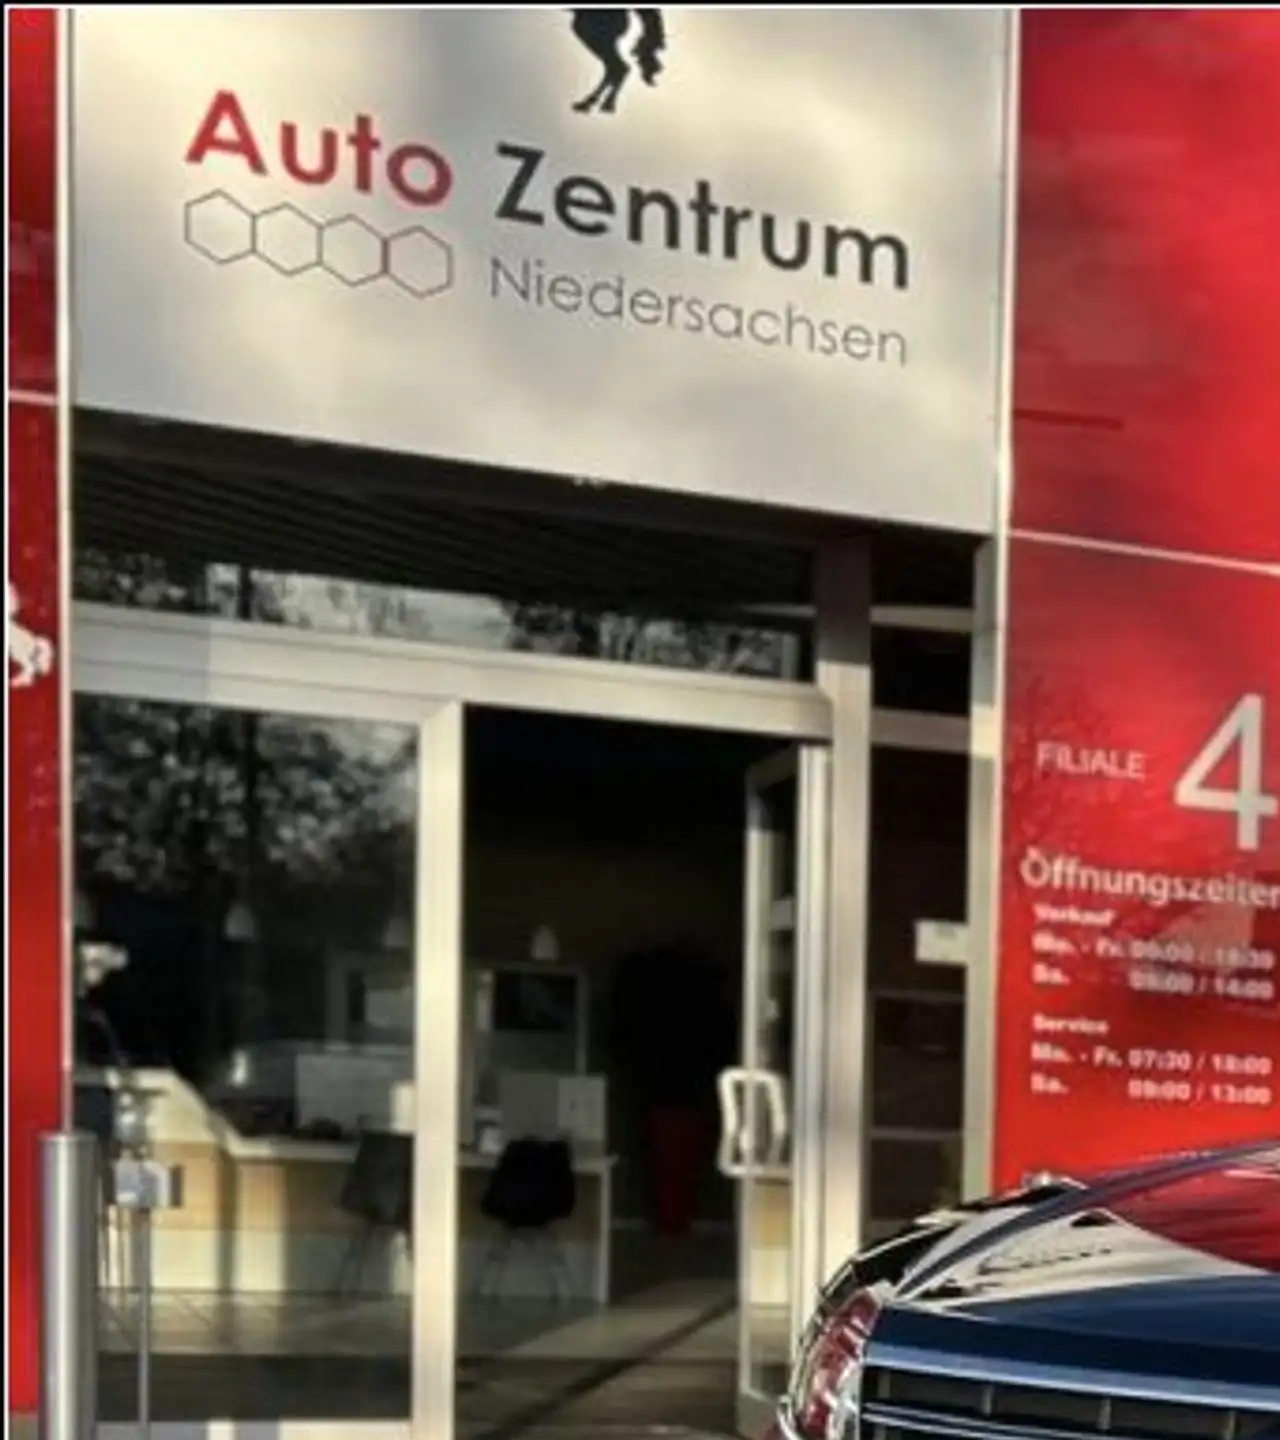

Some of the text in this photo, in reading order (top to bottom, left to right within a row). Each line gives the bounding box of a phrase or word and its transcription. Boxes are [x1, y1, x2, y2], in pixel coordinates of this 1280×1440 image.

[185, 89, 910, 290] Auto Zentrum
[489, 257, 908, 367] Niedersachsen
[1036, 742, 1145, 780] FILIALE
[1174, 694, 1280, 851] 4
[1032, 1014, 1110, 1034] Service
[1128, 1048, 1192, 1071] 07:30
